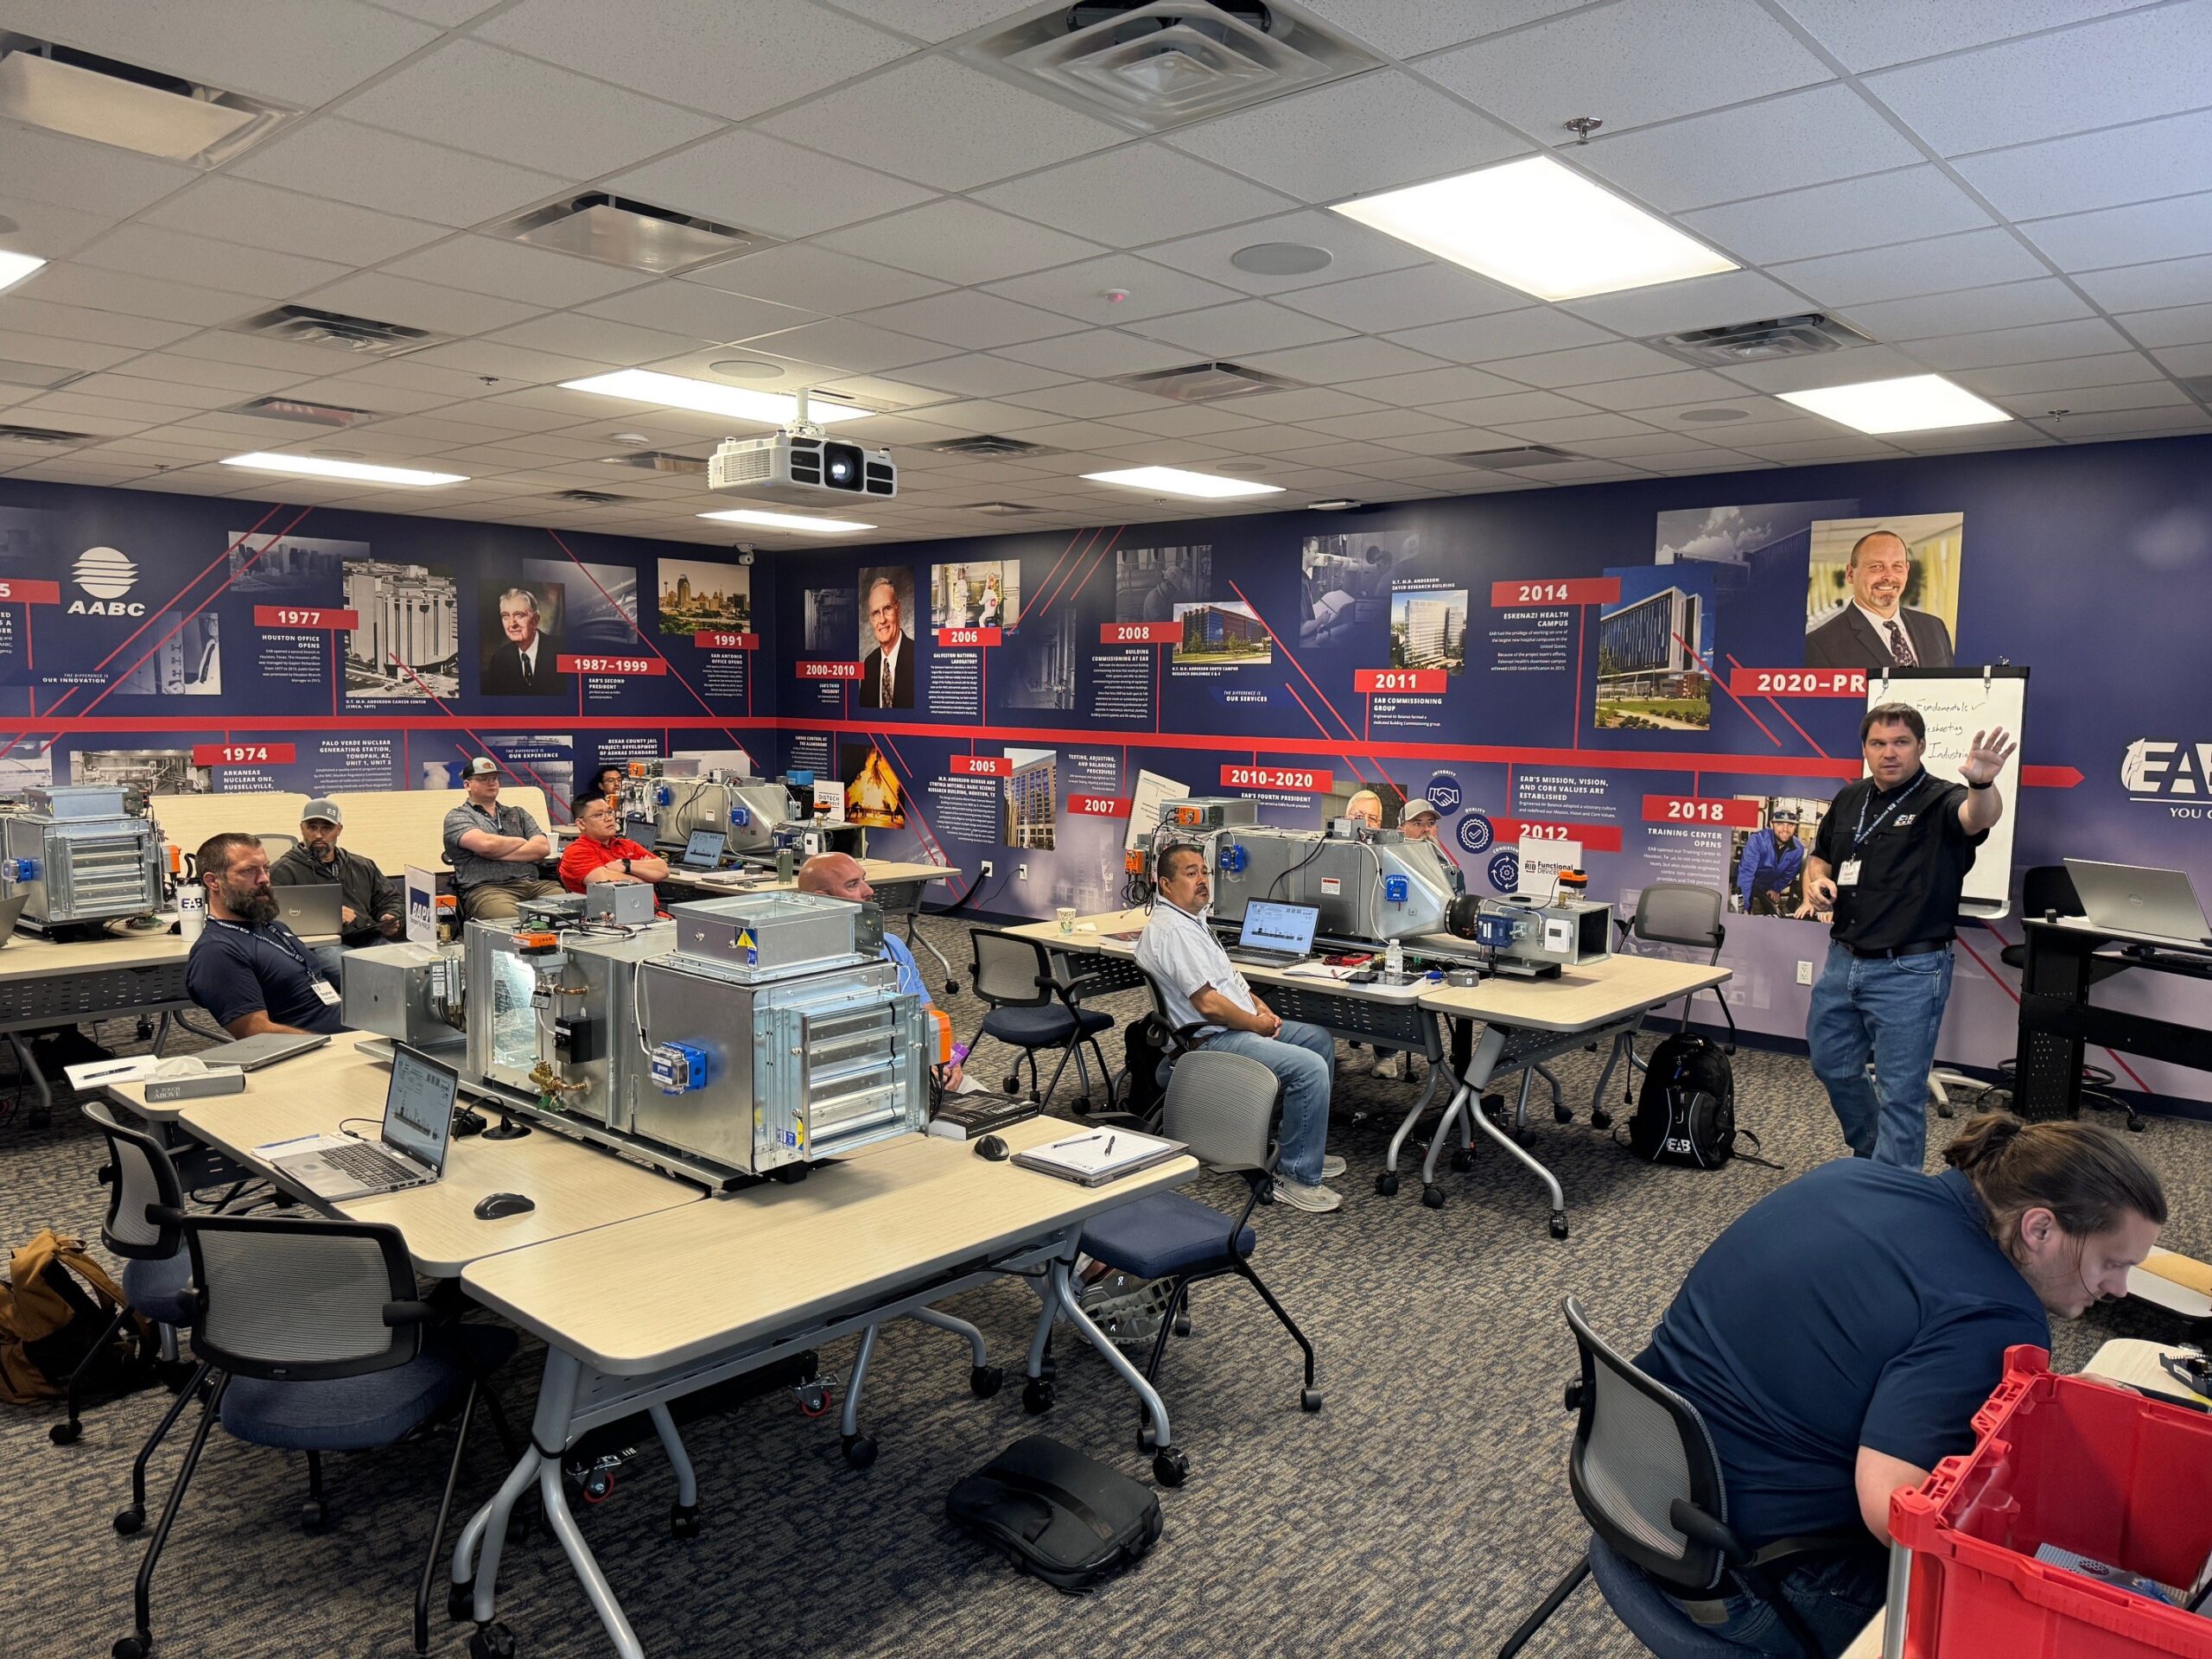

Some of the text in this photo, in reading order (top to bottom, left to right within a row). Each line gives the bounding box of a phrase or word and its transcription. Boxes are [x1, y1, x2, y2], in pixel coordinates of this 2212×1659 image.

[1519, 584, 1567, 601] 2014
[67, 601, 145, 617] AABC
[278, 611, 321, 625] 1977
[951, 631, 978, 643] 2006
[1118, 626, 1149, 639] 2008
[714, 635, 742, 646] 1991
[1376, 674, 1416, 689] 2011
[1916, 698, 1968, 712] Fundamentals
[223, 747, 267, 760] 1974
[969, 760, 995, 772] 2005
[1085, 799, 1115, 813] 2007
[1668, 801, 1723, 820] 2018
[2170, 807, 2202, 819] YOU
[1520, 823, 1567, 841] 2012
[1648, 828, 1722, 840] TRAINING CENTER
[1694, 840, 1722, 849] OPENS
[1538, 861, 1573, 871] Functional
[181, 898, 203, 908] EAB
[1666, 1137, 1691, 1151] EAB
